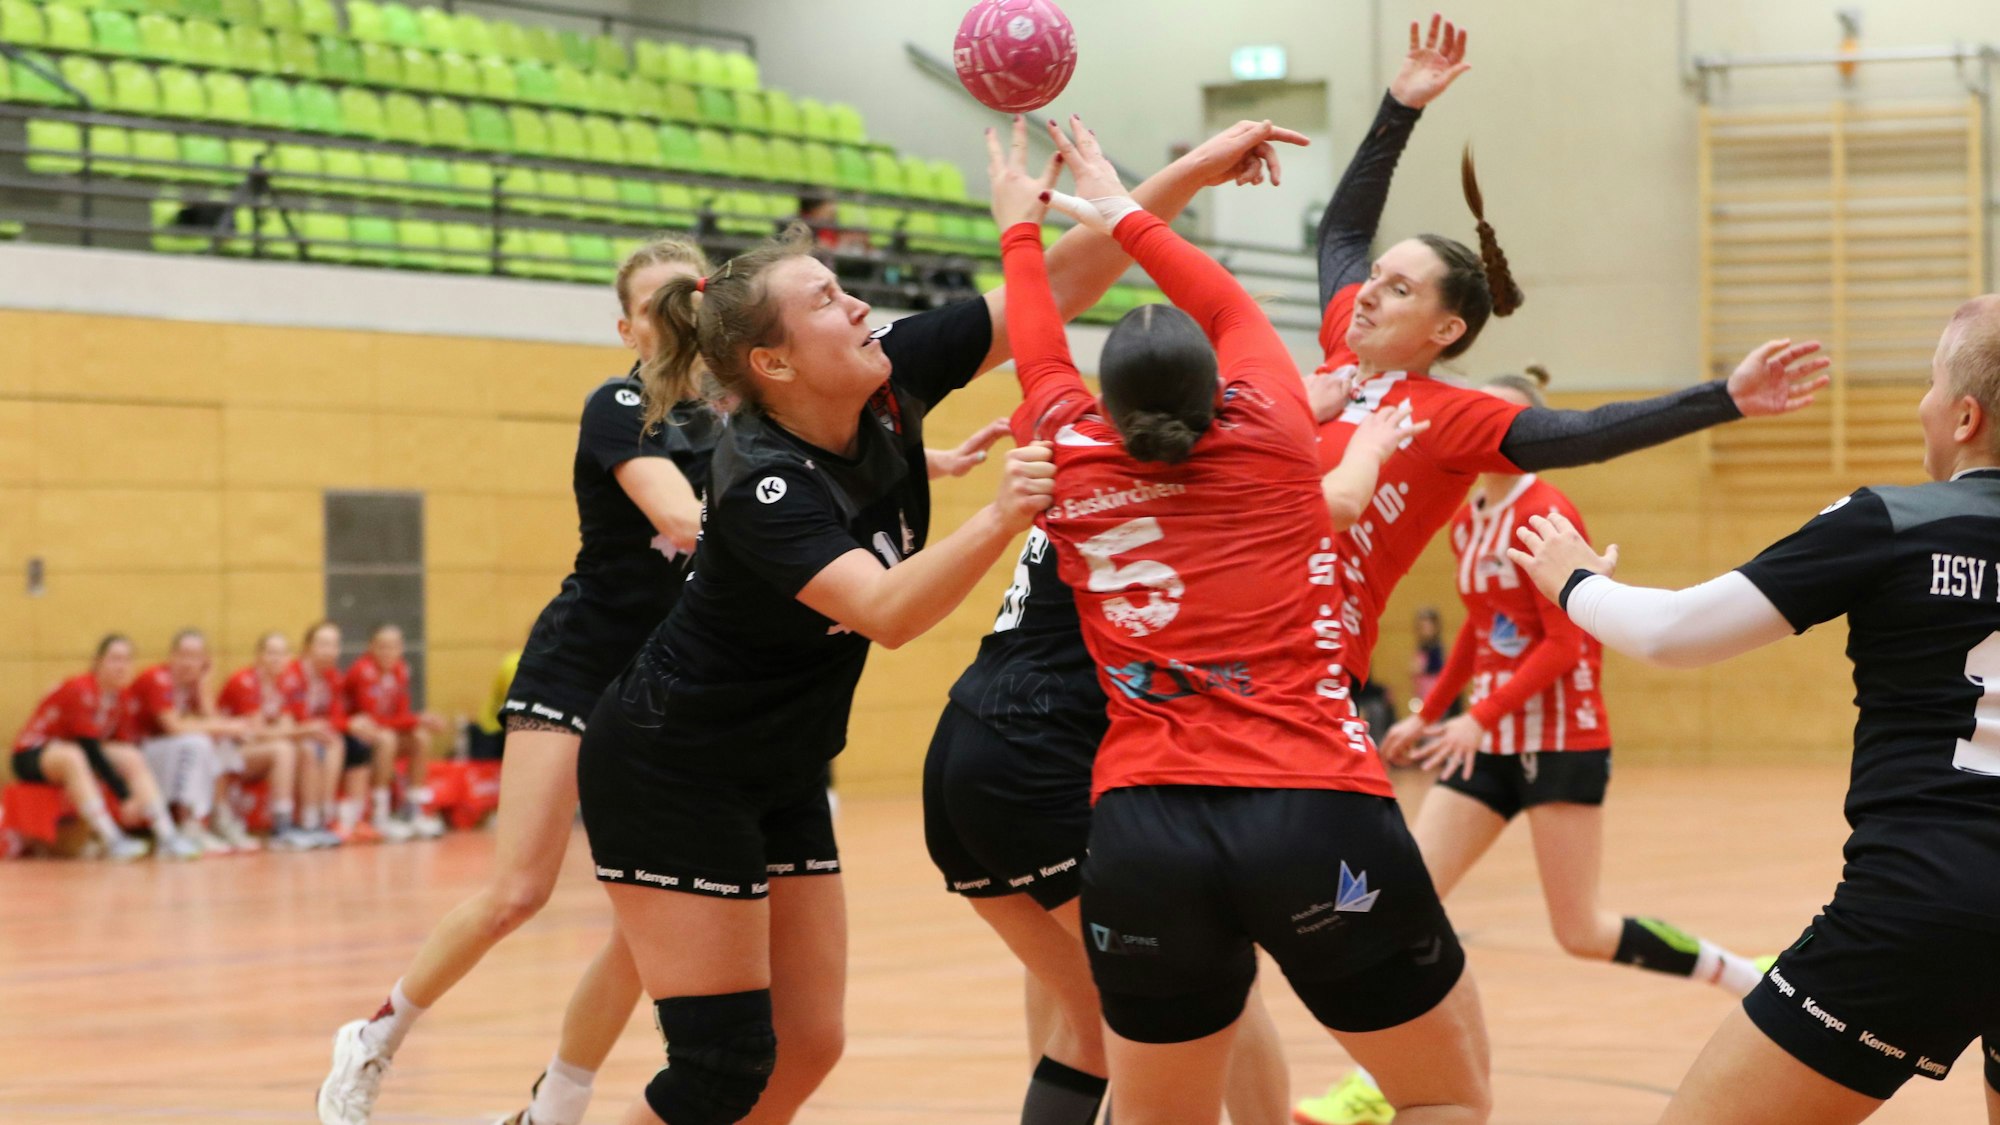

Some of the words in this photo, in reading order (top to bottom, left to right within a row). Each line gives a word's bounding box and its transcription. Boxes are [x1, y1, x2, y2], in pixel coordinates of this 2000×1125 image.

[1063, 480, 1187, 519] Euskirchen
[1074, 516, 1185, 637] 5
[1930, 553, 1986, 600] HSV
[635, 870, 679, 886] Kempa
[693, 878, 740, 895] Kempa
[953, 877, 991, 890] Kempa
[1039, 857, 1077, 878] Kempa
[1769, 966, 1796, 998] Kempa
[1801, 997, 1847, 1033] Kempa
[1858, 1030, 1907, 1060] Kempa
